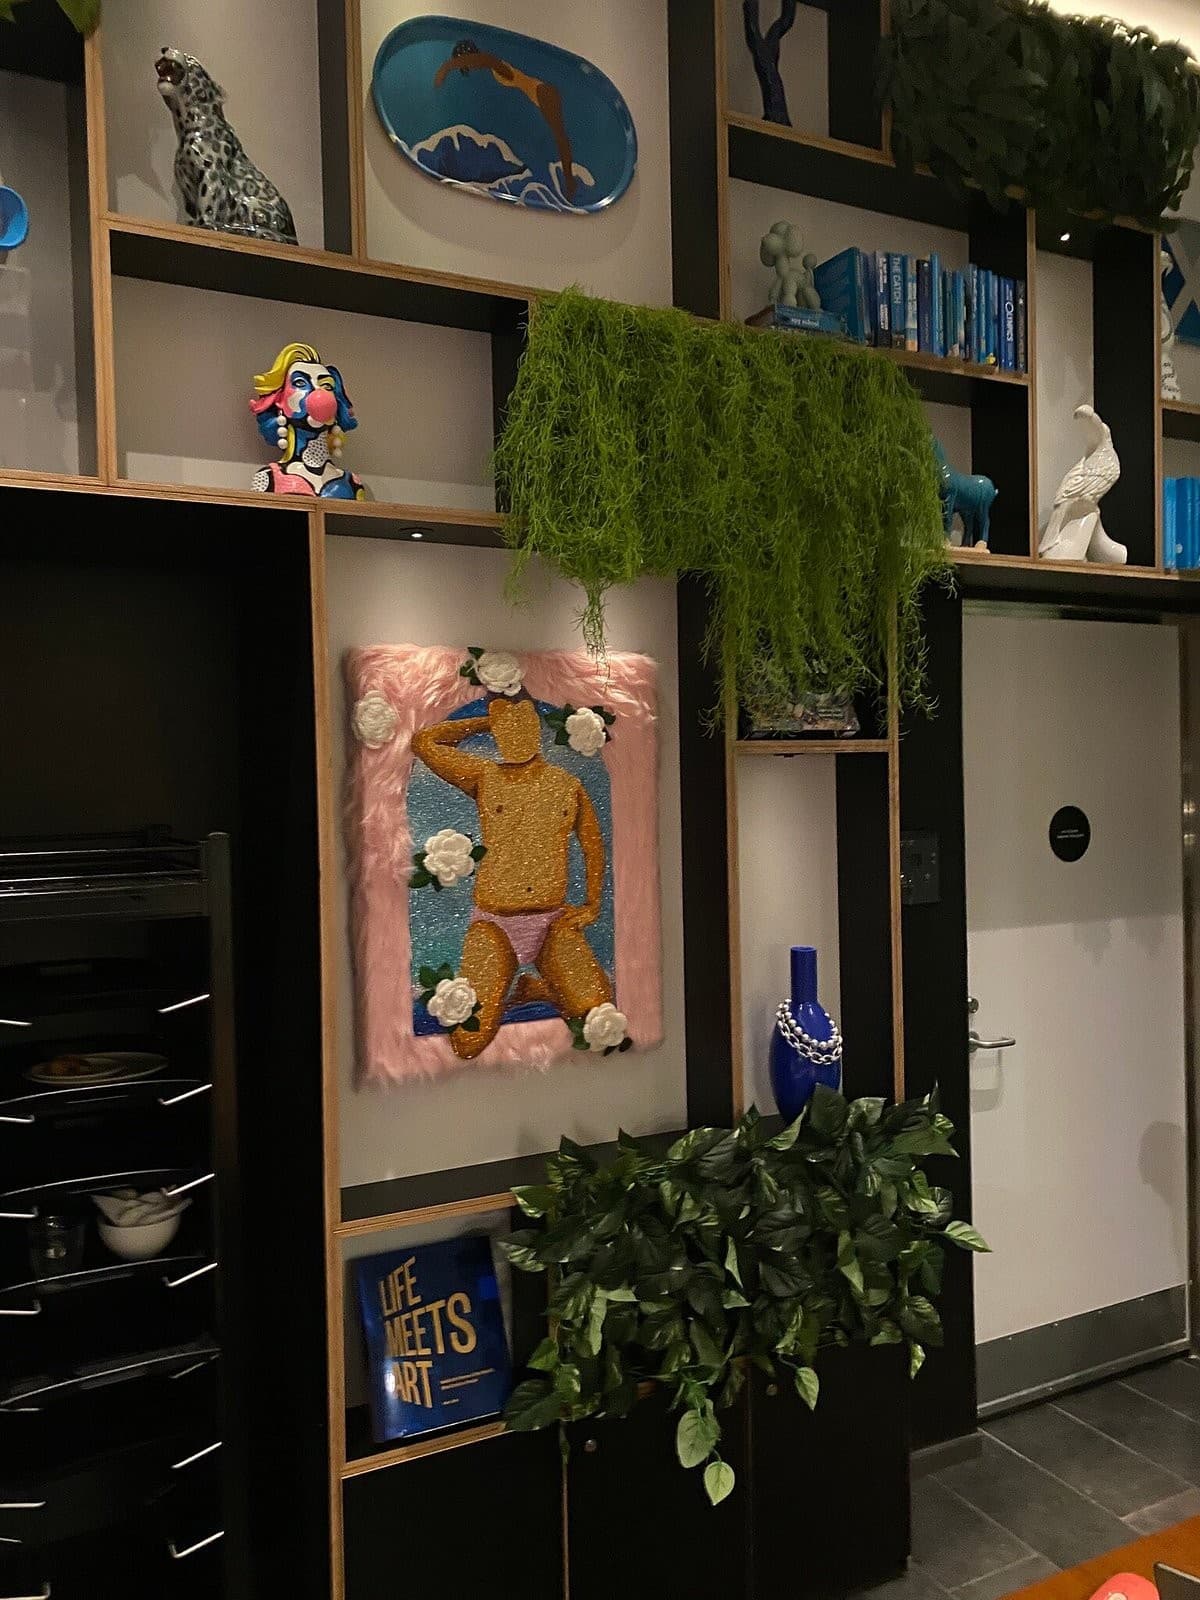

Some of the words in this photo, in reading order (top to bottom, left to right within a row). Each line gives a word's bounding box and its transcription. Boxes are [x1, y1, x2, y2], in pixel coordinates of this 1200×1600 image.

[893, 274, 902, 304] CATCH
[377, 1255, 422, 1317] LIFE
[383, 1291, 478, 1359] MEETS
[388, 1359, 433, 1409] ART
